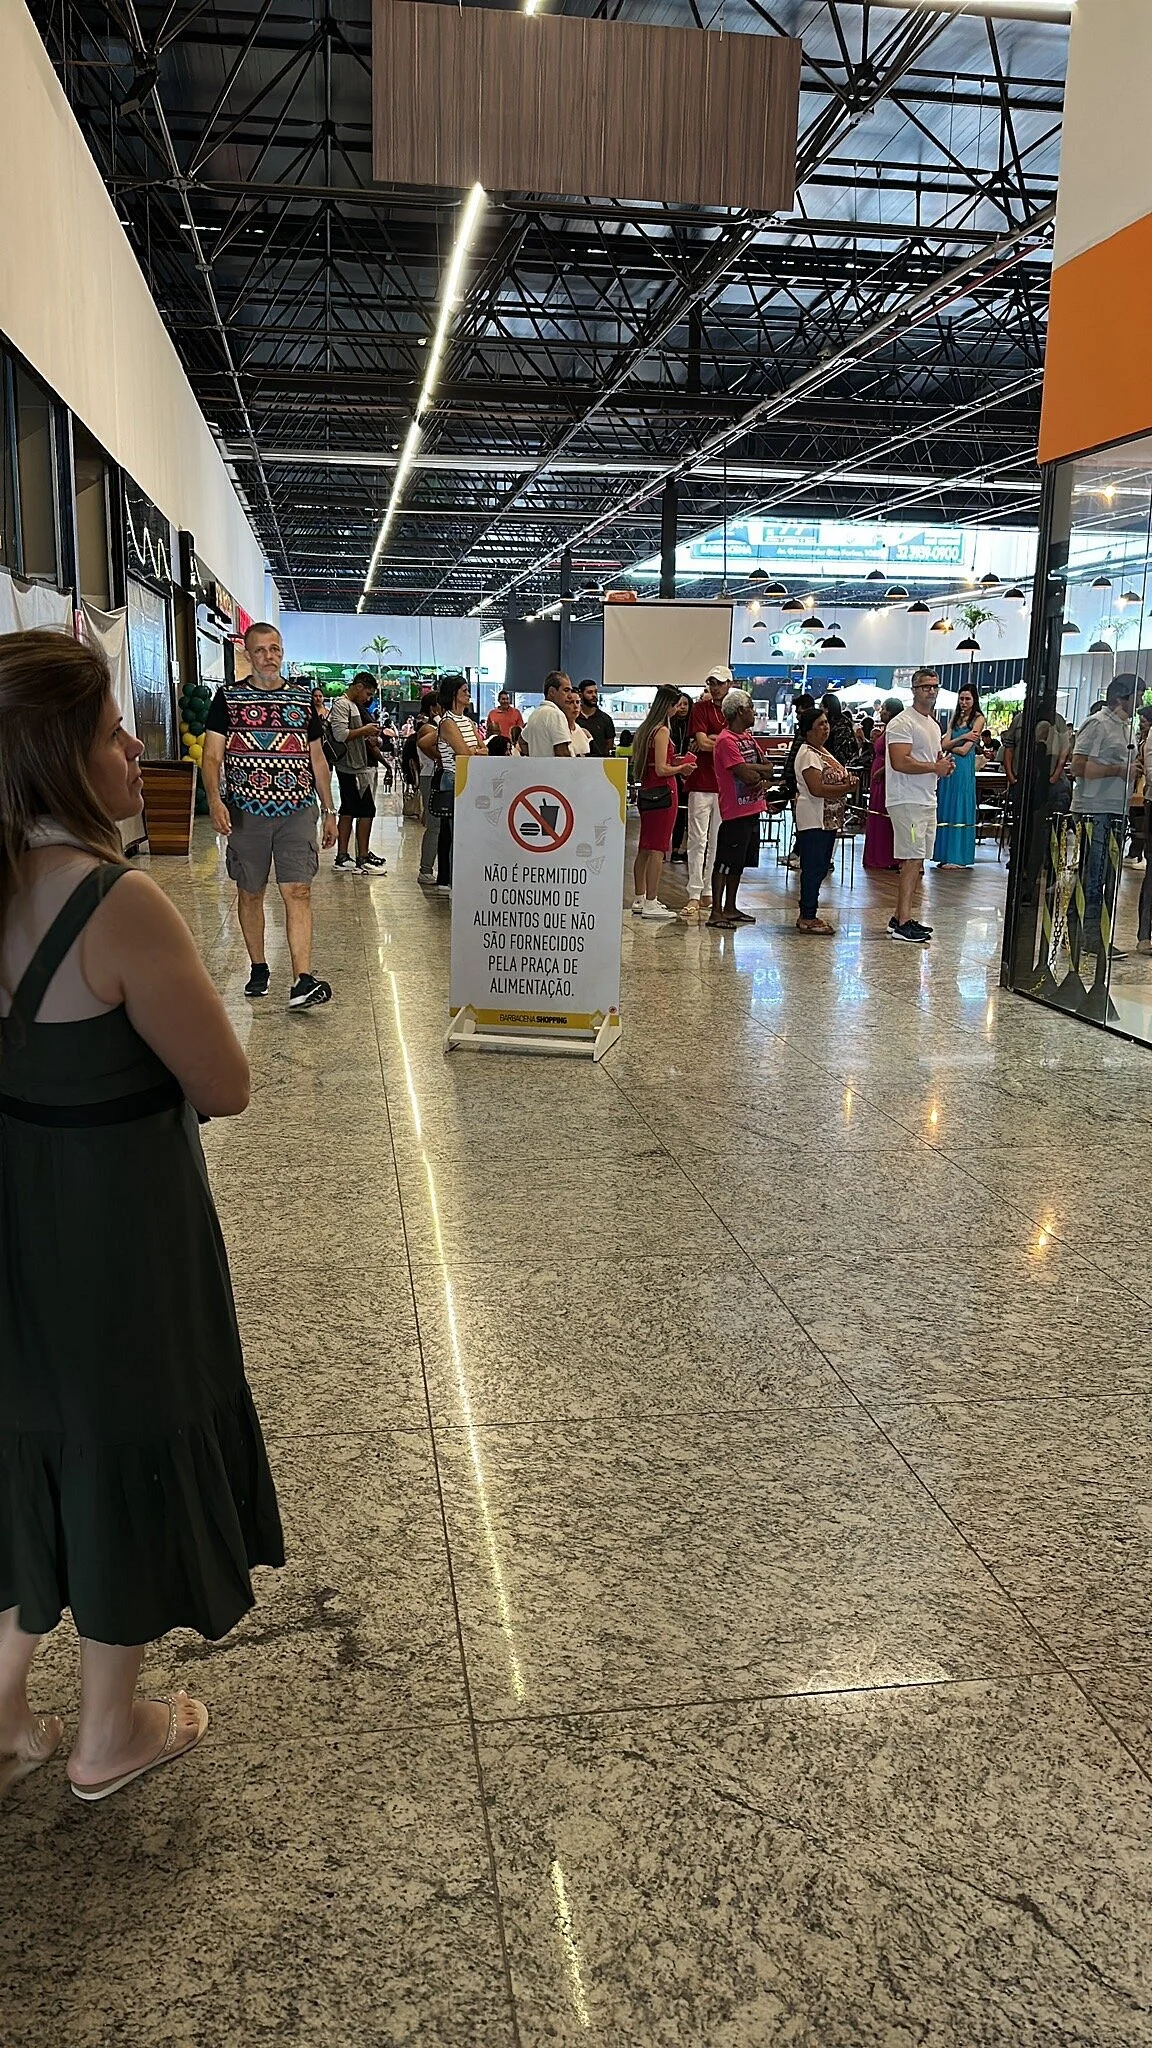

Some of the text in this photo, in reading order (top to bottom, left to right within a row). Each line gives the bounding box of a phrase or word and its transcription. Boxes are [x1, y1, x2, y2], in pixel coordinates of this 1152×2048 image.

[485, 863, 586, 884] NÃO É PERMITIDO
[491, 888, 579, 907] O CONSUMO DE
[473, 911, 594, 930] ALIMENTOS QUE NÃO
[483, 932, 584, 952] SÃO FORNECIDOS
[489, 955, 578, 976] PELA PRAÇA DE
[490, 978, 574, 998] ALIMENTAÇÃO.
[500, 1014, 567, 1024] BARBACENA SHOPPING
